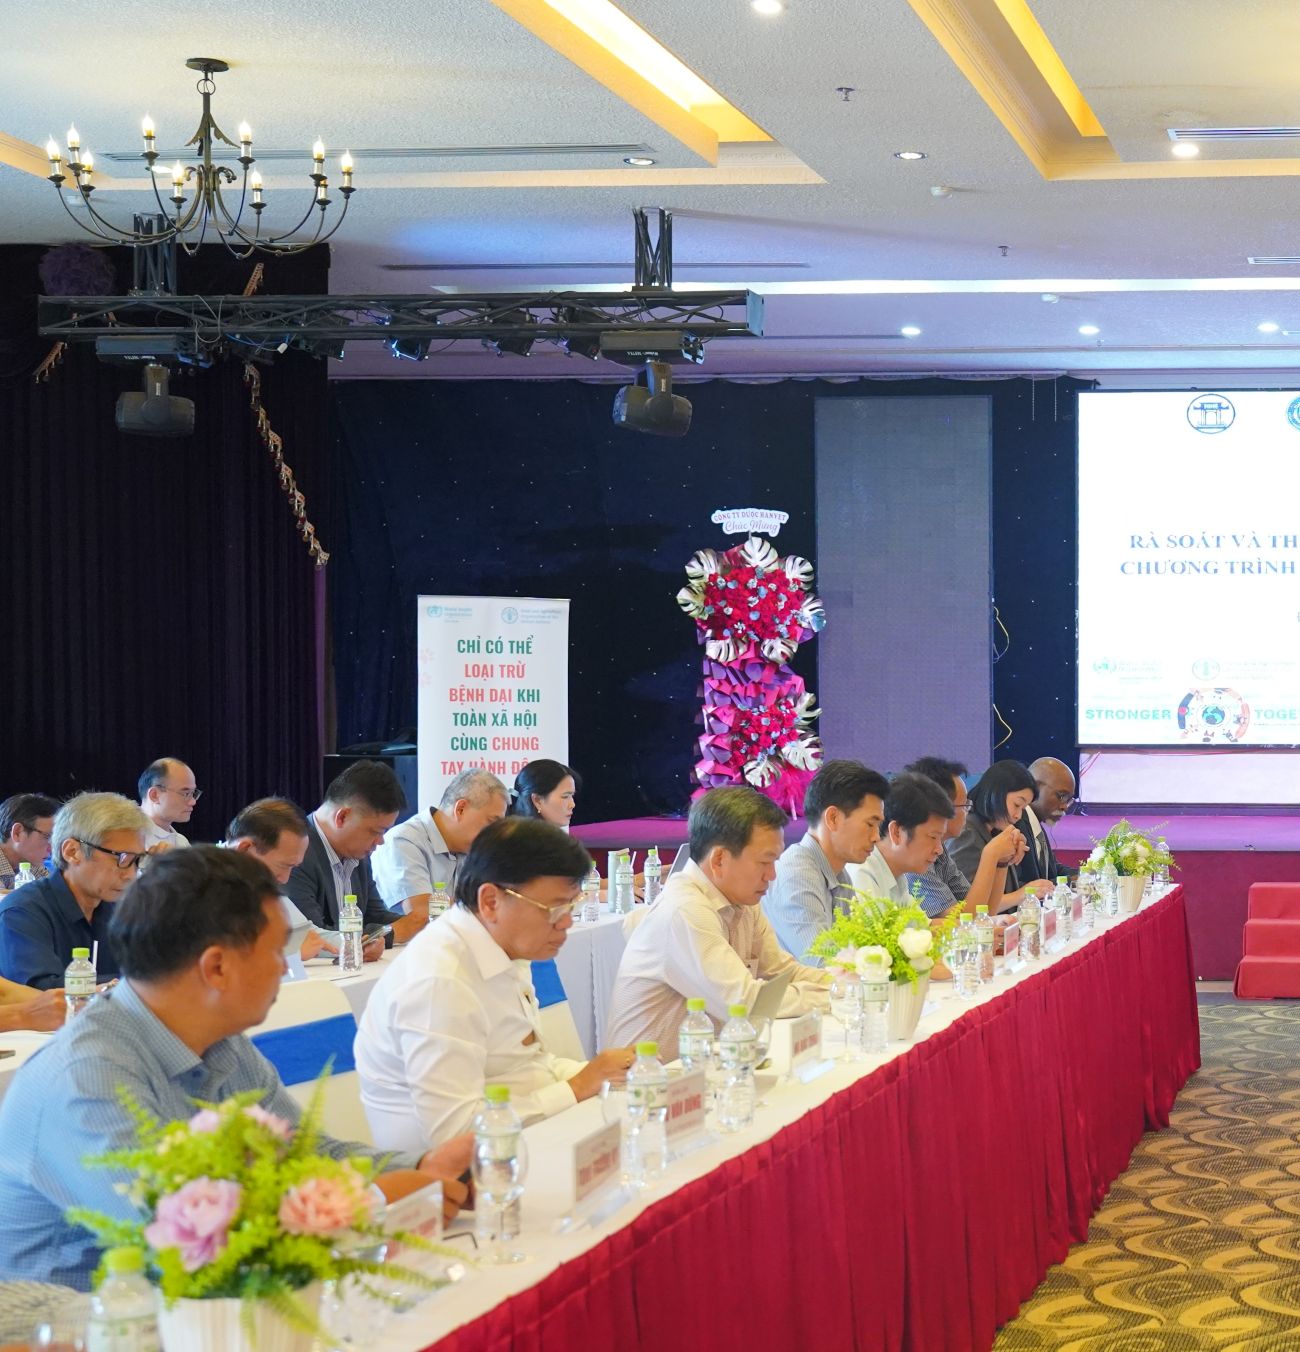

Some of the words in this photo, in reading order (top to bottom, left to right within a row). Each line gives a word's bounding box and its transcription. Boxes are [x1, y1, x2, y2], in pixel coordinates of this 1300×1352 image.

[1129, 531, 1160, 549] RÀ
[1166, 531, 1226, 549] SOÁT
[1231, 530, 1262, 549] VÀ
[1119, 559, 1220, 575] CHƯƠNG
[1225, 557, 1296, 575] TRÌNH
[457, 635, 481, 654] CHỈ
[485, 635, 504, 654] CÓ
[508, 634, 534, 655] THỂ
[464, 663, 494, 682] LOẠI
[499, 661, 527, 679] TRỪ
[449, 684, 485, 705] BỆNH
[489, 688, 512, 705] DẠI
[517, 688, 540, 703] KHI
[452, 708, 487, 727] TOÀN
[491, 709, 509, 727] XÃ
[513, 709, 537, 730] HỘI
[1085, 708, 1172, 720] STRONGER
[450, 733, 488, 751] CÙNG
[492, 736, 539, 751] CHUNG
[441, 760, 464, 776] TAY
